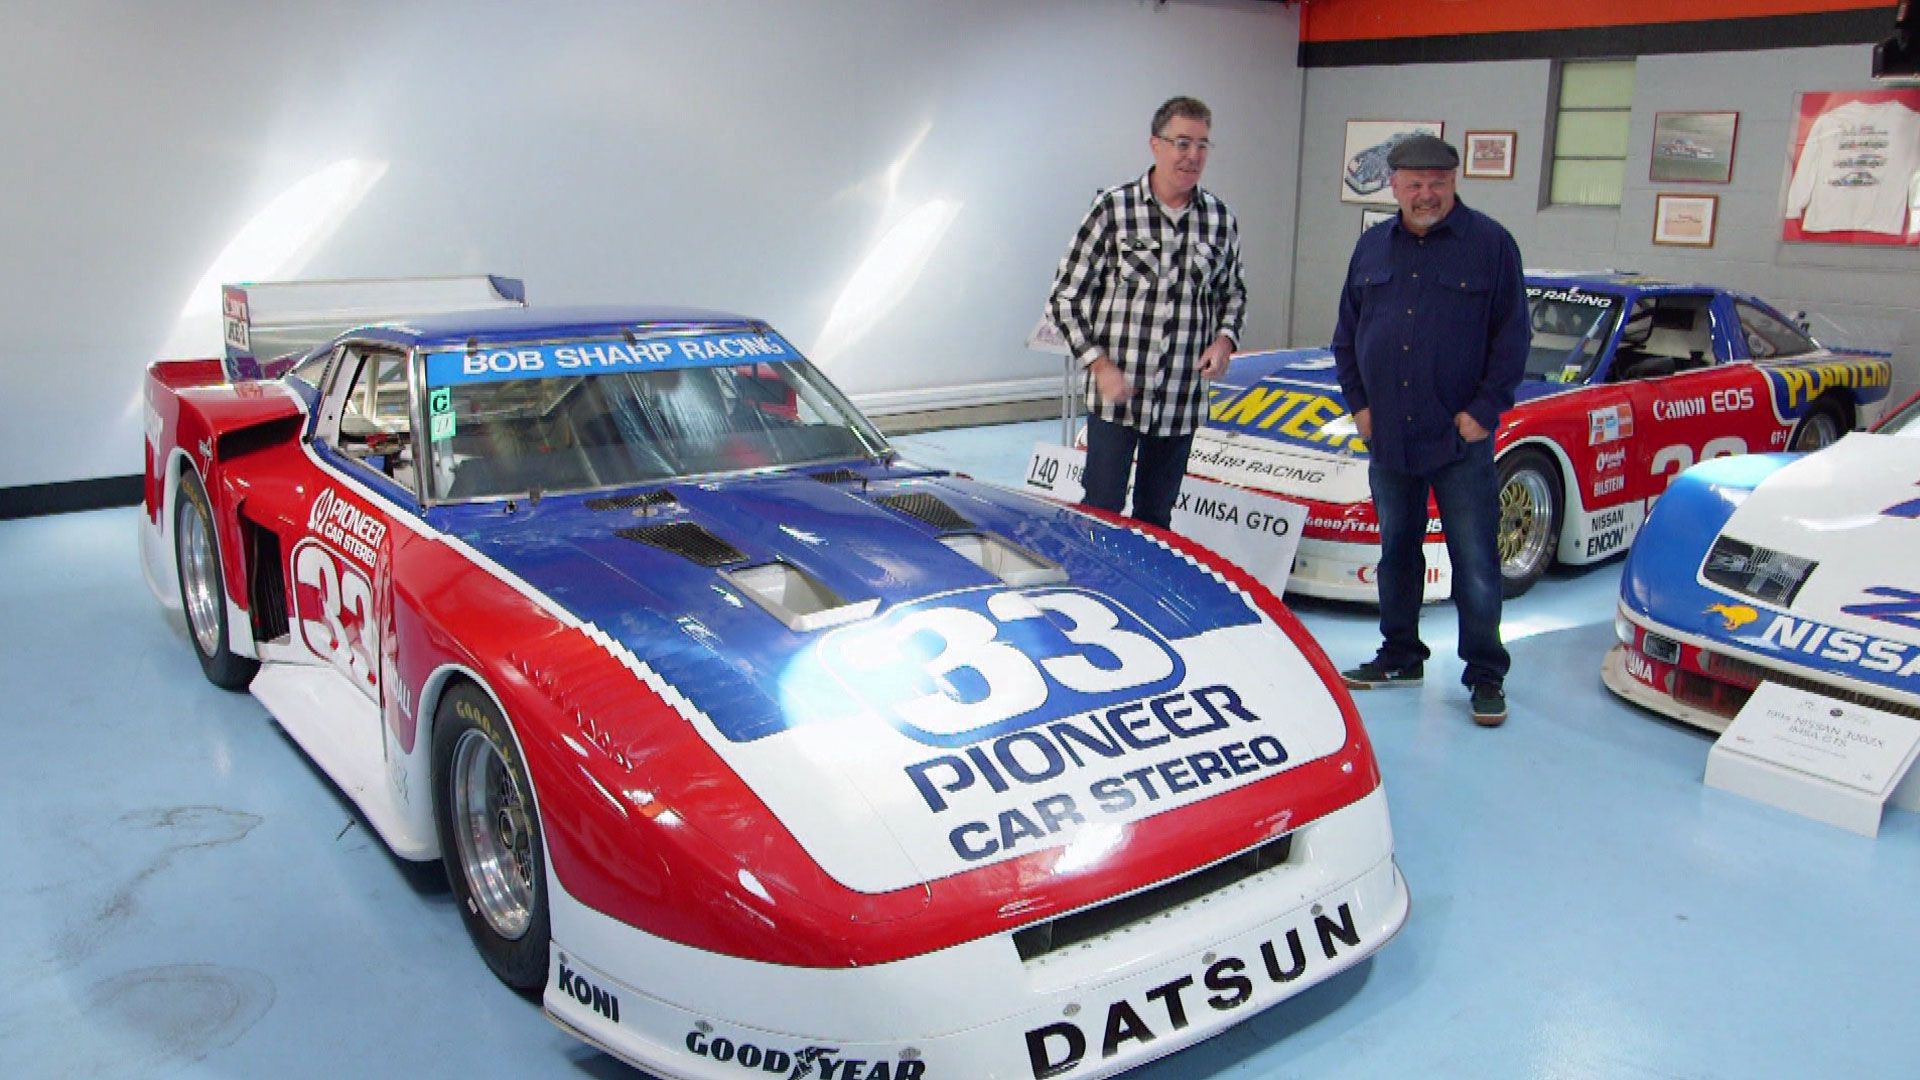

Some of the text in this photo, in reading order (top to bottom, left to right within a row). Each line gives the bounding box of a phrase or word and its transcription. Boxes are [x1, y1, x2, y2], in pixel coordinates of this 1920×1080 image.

[464, 335, 785, 375] BOB SHARP RACING
[1652, 387, 1754, 422] Canon EOS
[1030, 454, 1058, 483] 140
[1065, 464, 1086, 483] 198
[1194, 494, 1238, 525] IMSA
[1246, 512, 1289, 537] GTO
[1246, 460, 1325, 484] RACING
[1594, 474, 1625, 498] BILSTEIN
[324, 522, 377, 568] CAR STEREO
[330, 498, 387, 550] PIONEER
[1592, 508, 1624, 532] NISSAN
[298, 545, 378, 702] 33
[846, 591, 1171, 736] 33
[904, 684, 1261, 814] PIONEER
[949, 735, 1290, 862] CAR STEREO
[558, 963, 620, 1023] KONI
[1025, 903, 1361, 1080] DATSUN
